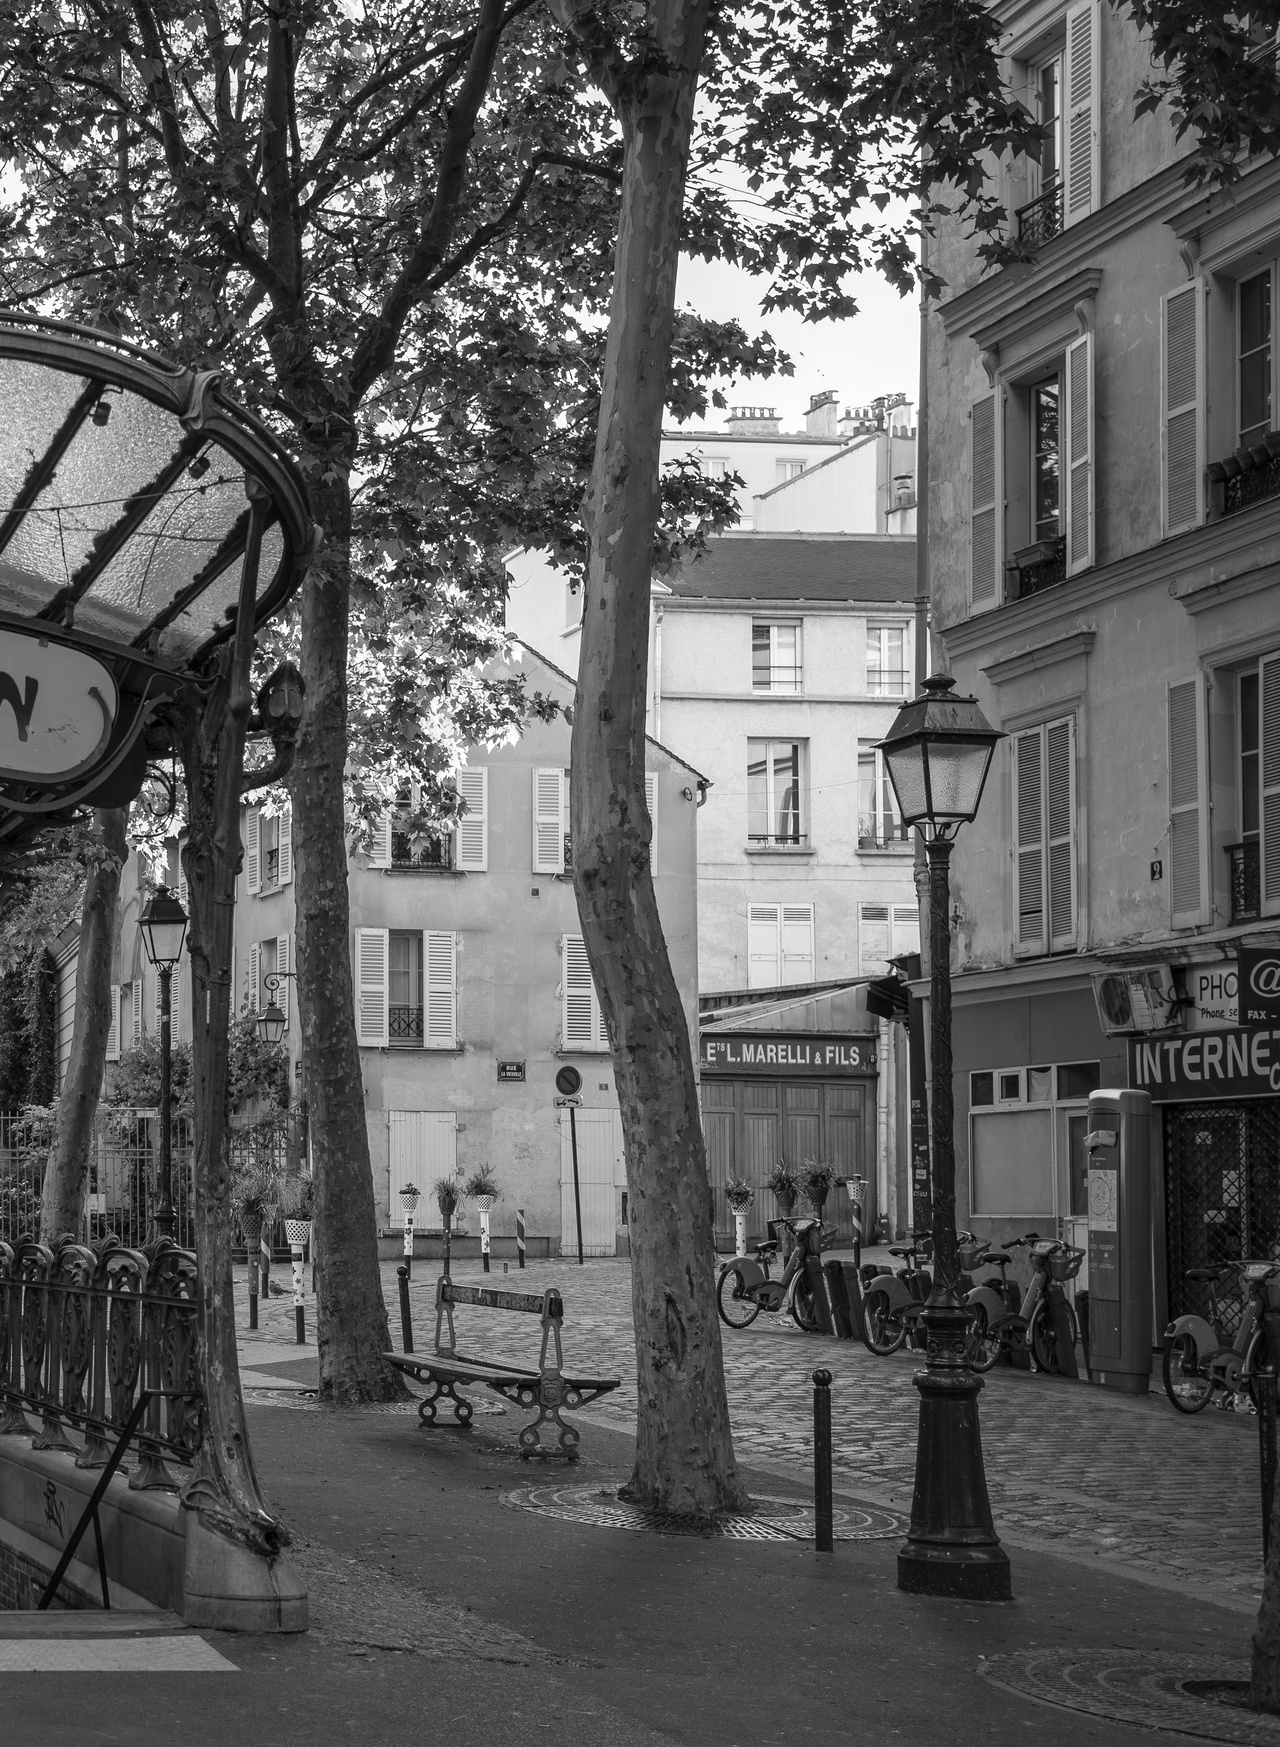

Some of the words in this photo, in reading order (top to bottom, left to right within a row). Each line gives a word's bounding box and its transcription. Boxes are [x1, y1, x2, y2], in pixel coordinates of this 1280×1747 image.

[1153, 862, 1160, 879] 2
[1199, 972, 1238, 1001] PHO
[1201, 1007, 1225, 1019] Phone
[1247, 1010, 1267, 1020] FAX
[742, 1044, 810, 1064] MARELLI
[815, 1052, 821, 1064] &
[826, 1046, 860, 1066] FILS
